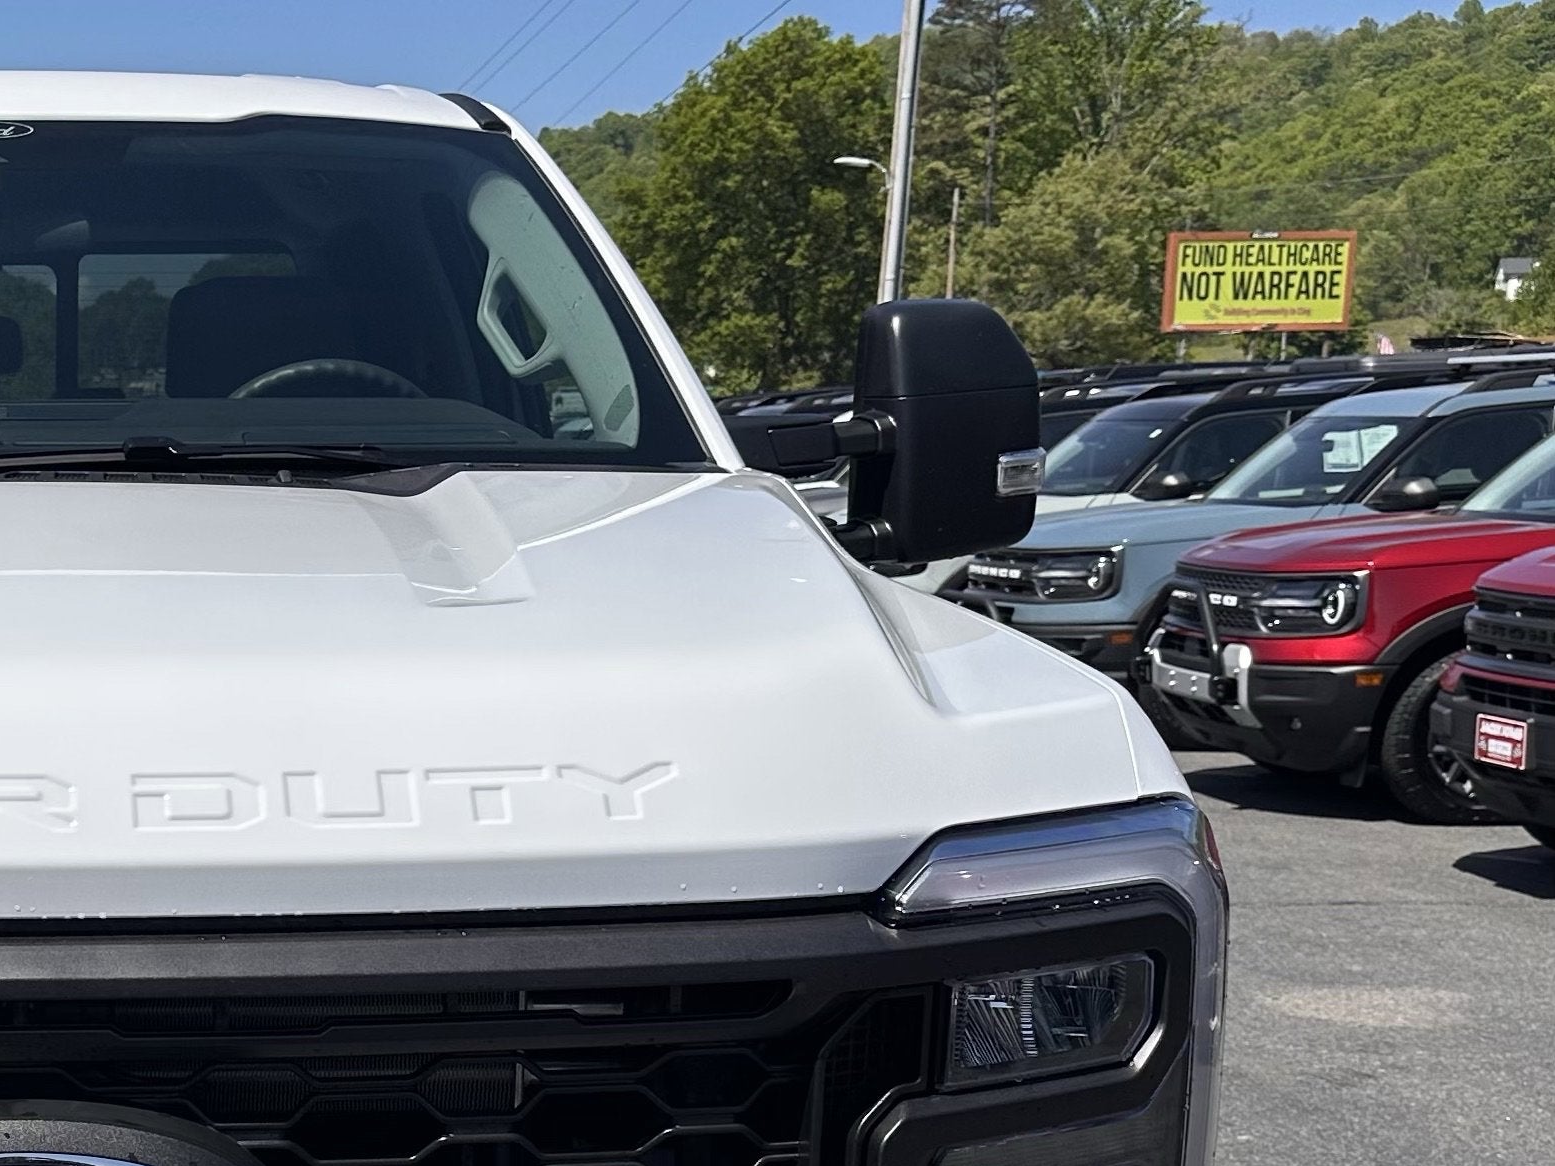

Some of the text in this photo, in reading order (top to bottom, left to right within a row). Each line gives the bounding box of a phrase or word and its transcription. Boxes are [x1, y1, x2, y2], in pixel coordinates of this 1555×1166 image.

[1181, 243, 1344, 267] FUND HEALTHCARE
[1179, 270, 1343, 301] NOT WARFARE
[131, 761, 680, 831] DUTY
